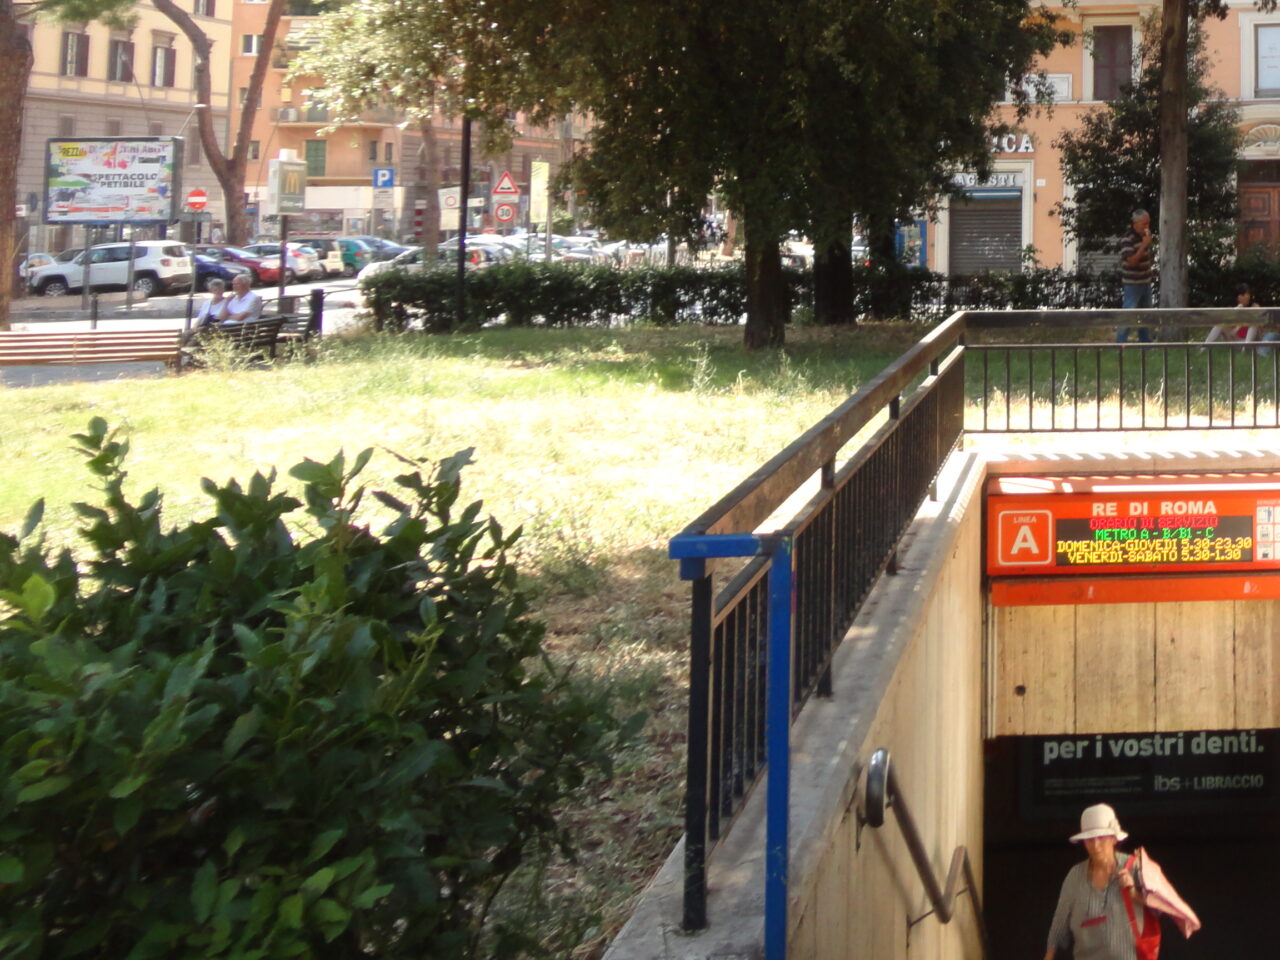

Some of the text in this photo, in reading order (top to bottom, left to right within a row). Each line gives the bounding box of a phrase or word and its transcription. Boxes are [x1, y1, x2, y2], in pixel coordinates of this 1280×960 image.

[377, 170, 391, 186] P
[1092, 500, 1217, 517] RE DI ROMA
[1090, 516, 1219, 529] ORARIO DI SERVIZIO
[1010, 525, 1040, 554] A
[1095, 528, 1137, 540] METRO
[1141, 528, 1149, 540] A
[1162, 527, 1193, 539] B/B1
[1205, 527, 1215, 538] C
[1181, 537, 1252, 550] 5.30-23.30
[1181, 548, 1242, 561] 5.30-1.30
[1044, 730, 1264, 765] per i vostri denti.
